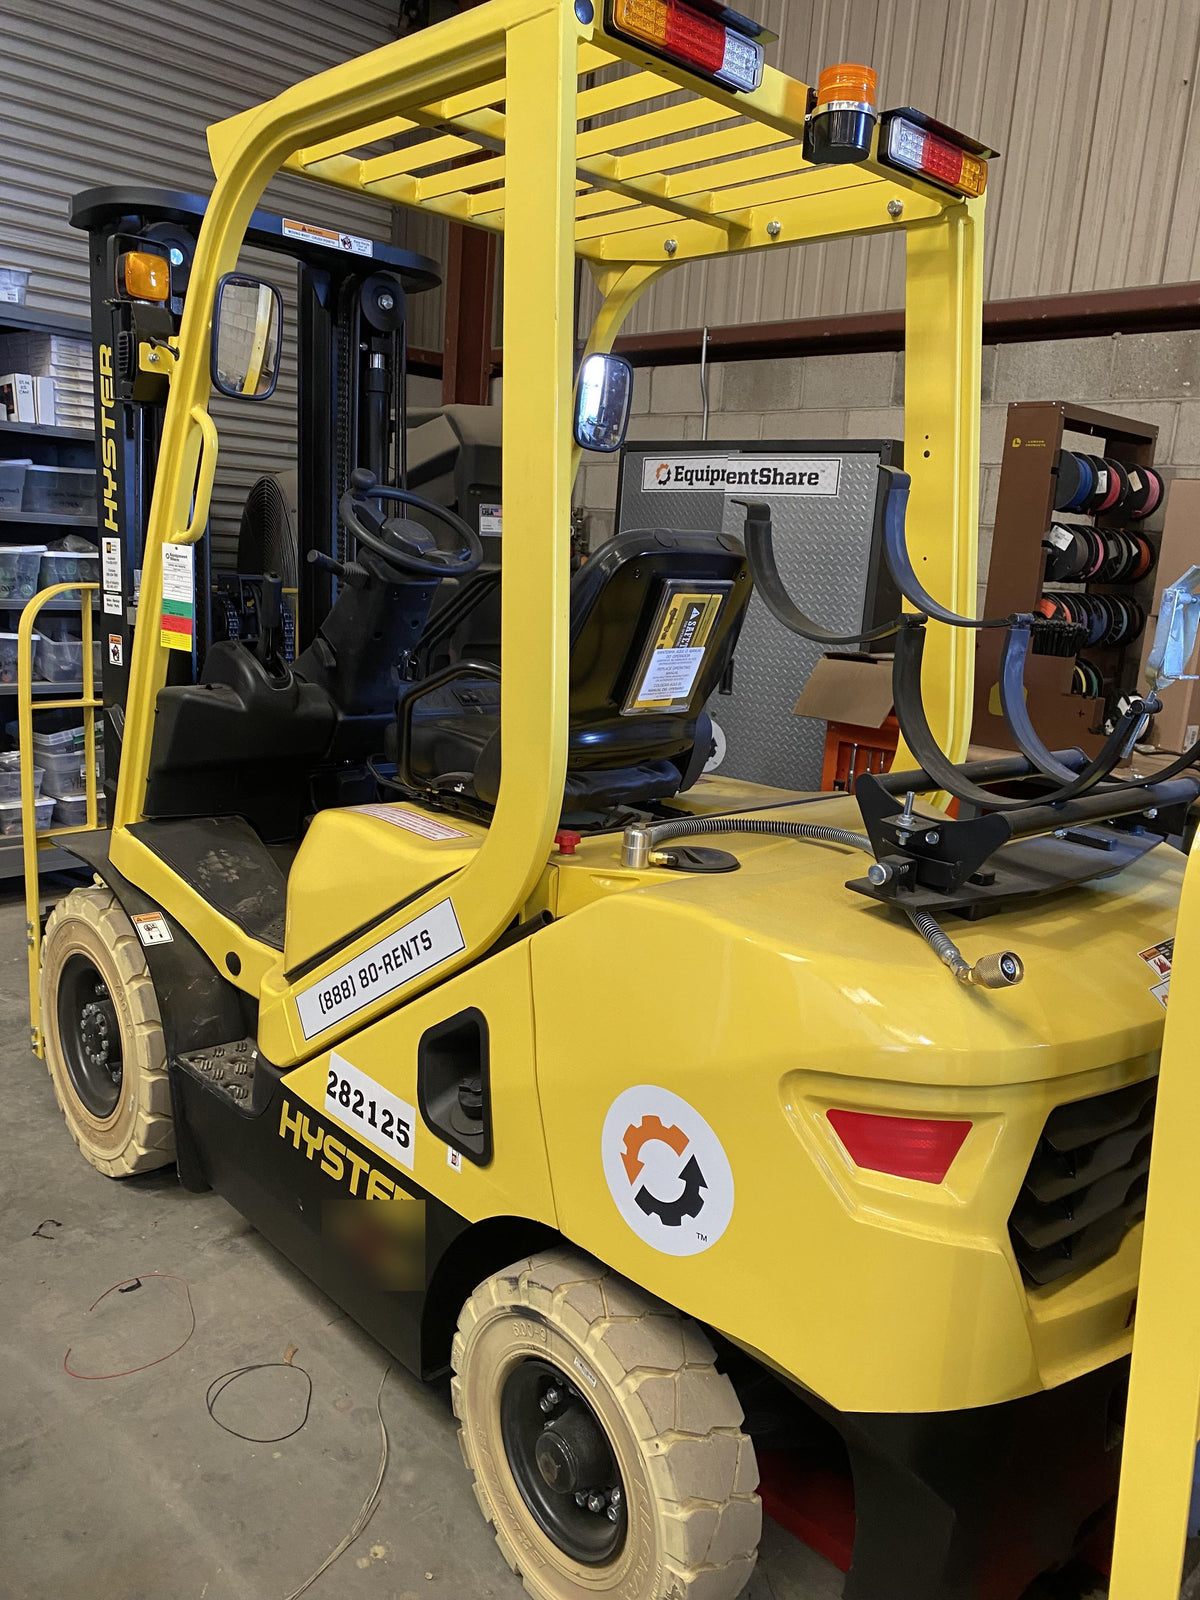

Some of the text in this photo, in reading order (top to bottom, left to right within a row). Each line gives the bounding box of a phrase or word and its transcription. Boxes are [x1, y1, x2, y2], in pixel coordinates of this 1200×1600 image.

[100, 344, 118, 532] HYSTER
[318, 929, 432, 1015] (888) 80-RENTS
[278, 1099, 417, 1200] HYSTE
[326, 1070, 410, 1149] 282125
